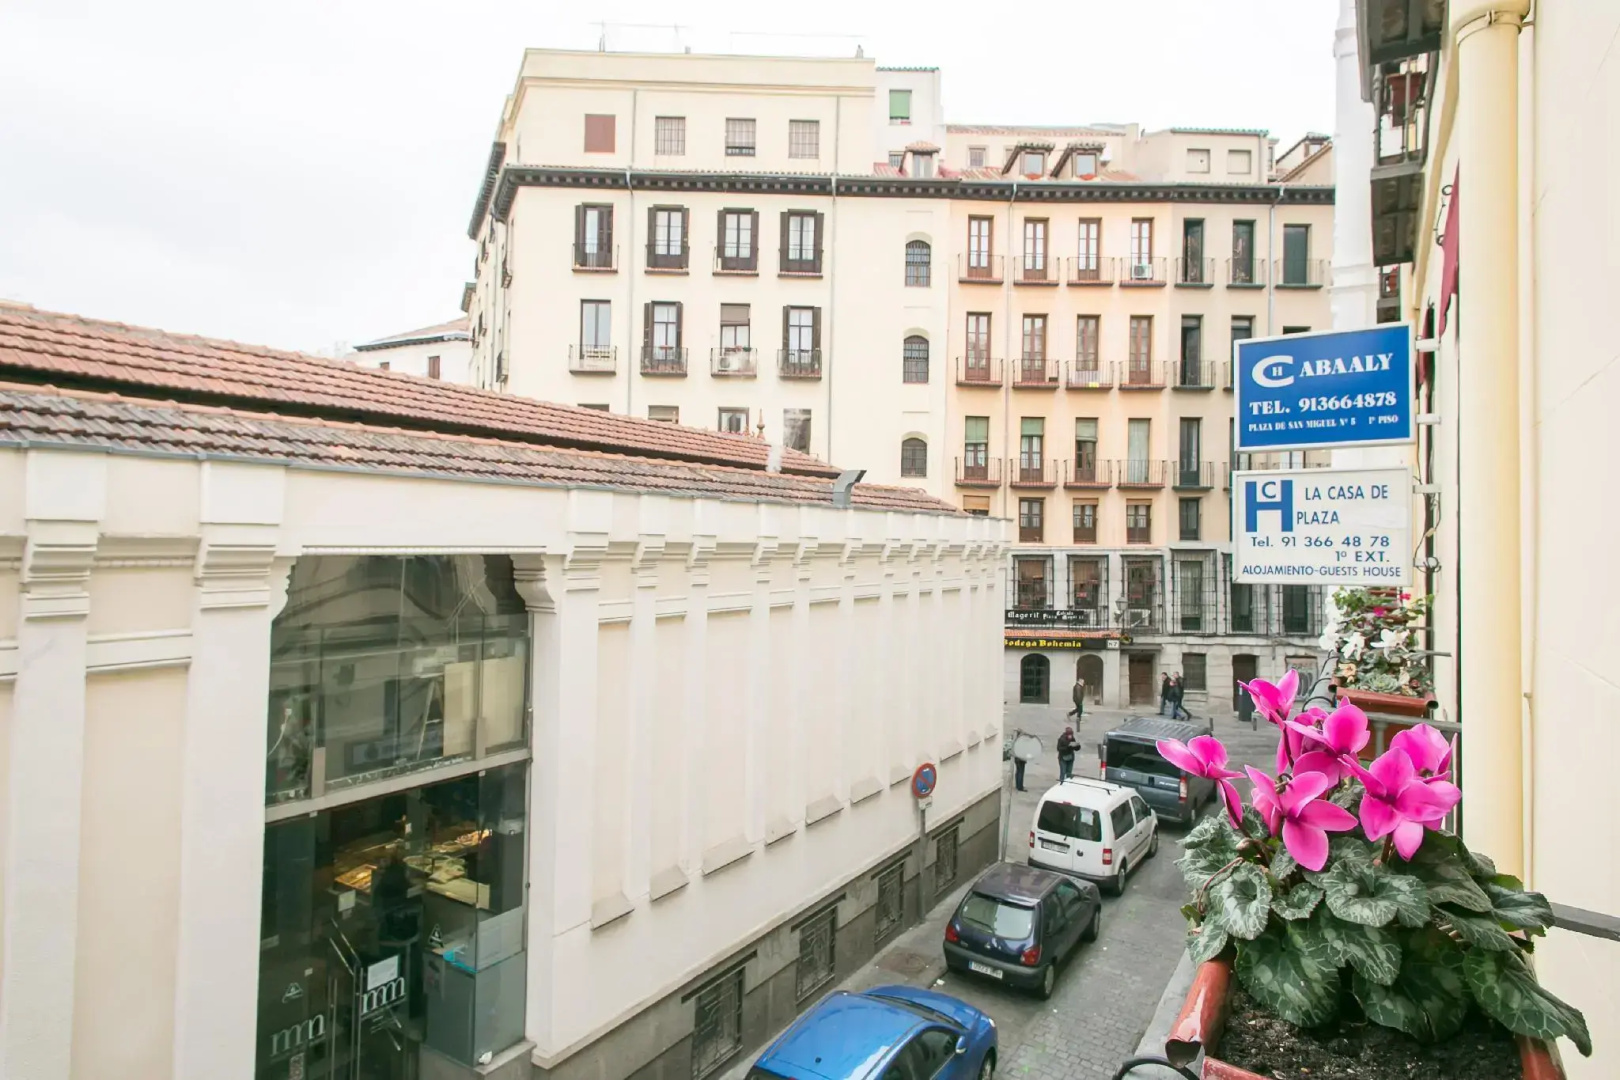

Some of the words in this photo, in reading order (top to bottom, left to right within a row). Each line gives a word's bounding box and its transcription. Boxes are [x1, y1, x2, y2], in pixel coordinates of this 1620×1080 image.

[1249, 400, 1290, 415] TEL.
[1298, 391, 1397, 412] 913664878
[1248, 423, 1273, 432] PLAZA
[1275, 421, 1286, 430] DE
[1288, 420, 1303, 429] SAN
[1306, 419, 1336, 428] MIGUEL
[1378, 414, 1399, 424] PISO
[1305, 487, 1321, 500] LA
[1327, 485, 1364, 500] CASA
[1371, 485, 1388, 499] DE
[1296, 511, 1340, 525] PLAZA
[1251, 536, 1273, 547] Tel.
[1281, 536, 1296, 547] 91
[1304, 536, 1333, 547] 366
[1341, 536, 1361, 547] 48
[1370, 536, 1390, 547] 78
[1355, 551, 1390, 562] EXT.
[1363, 566, 1401, 577] HOUSE
[1039, 639, 1082, 648] Bohemia
